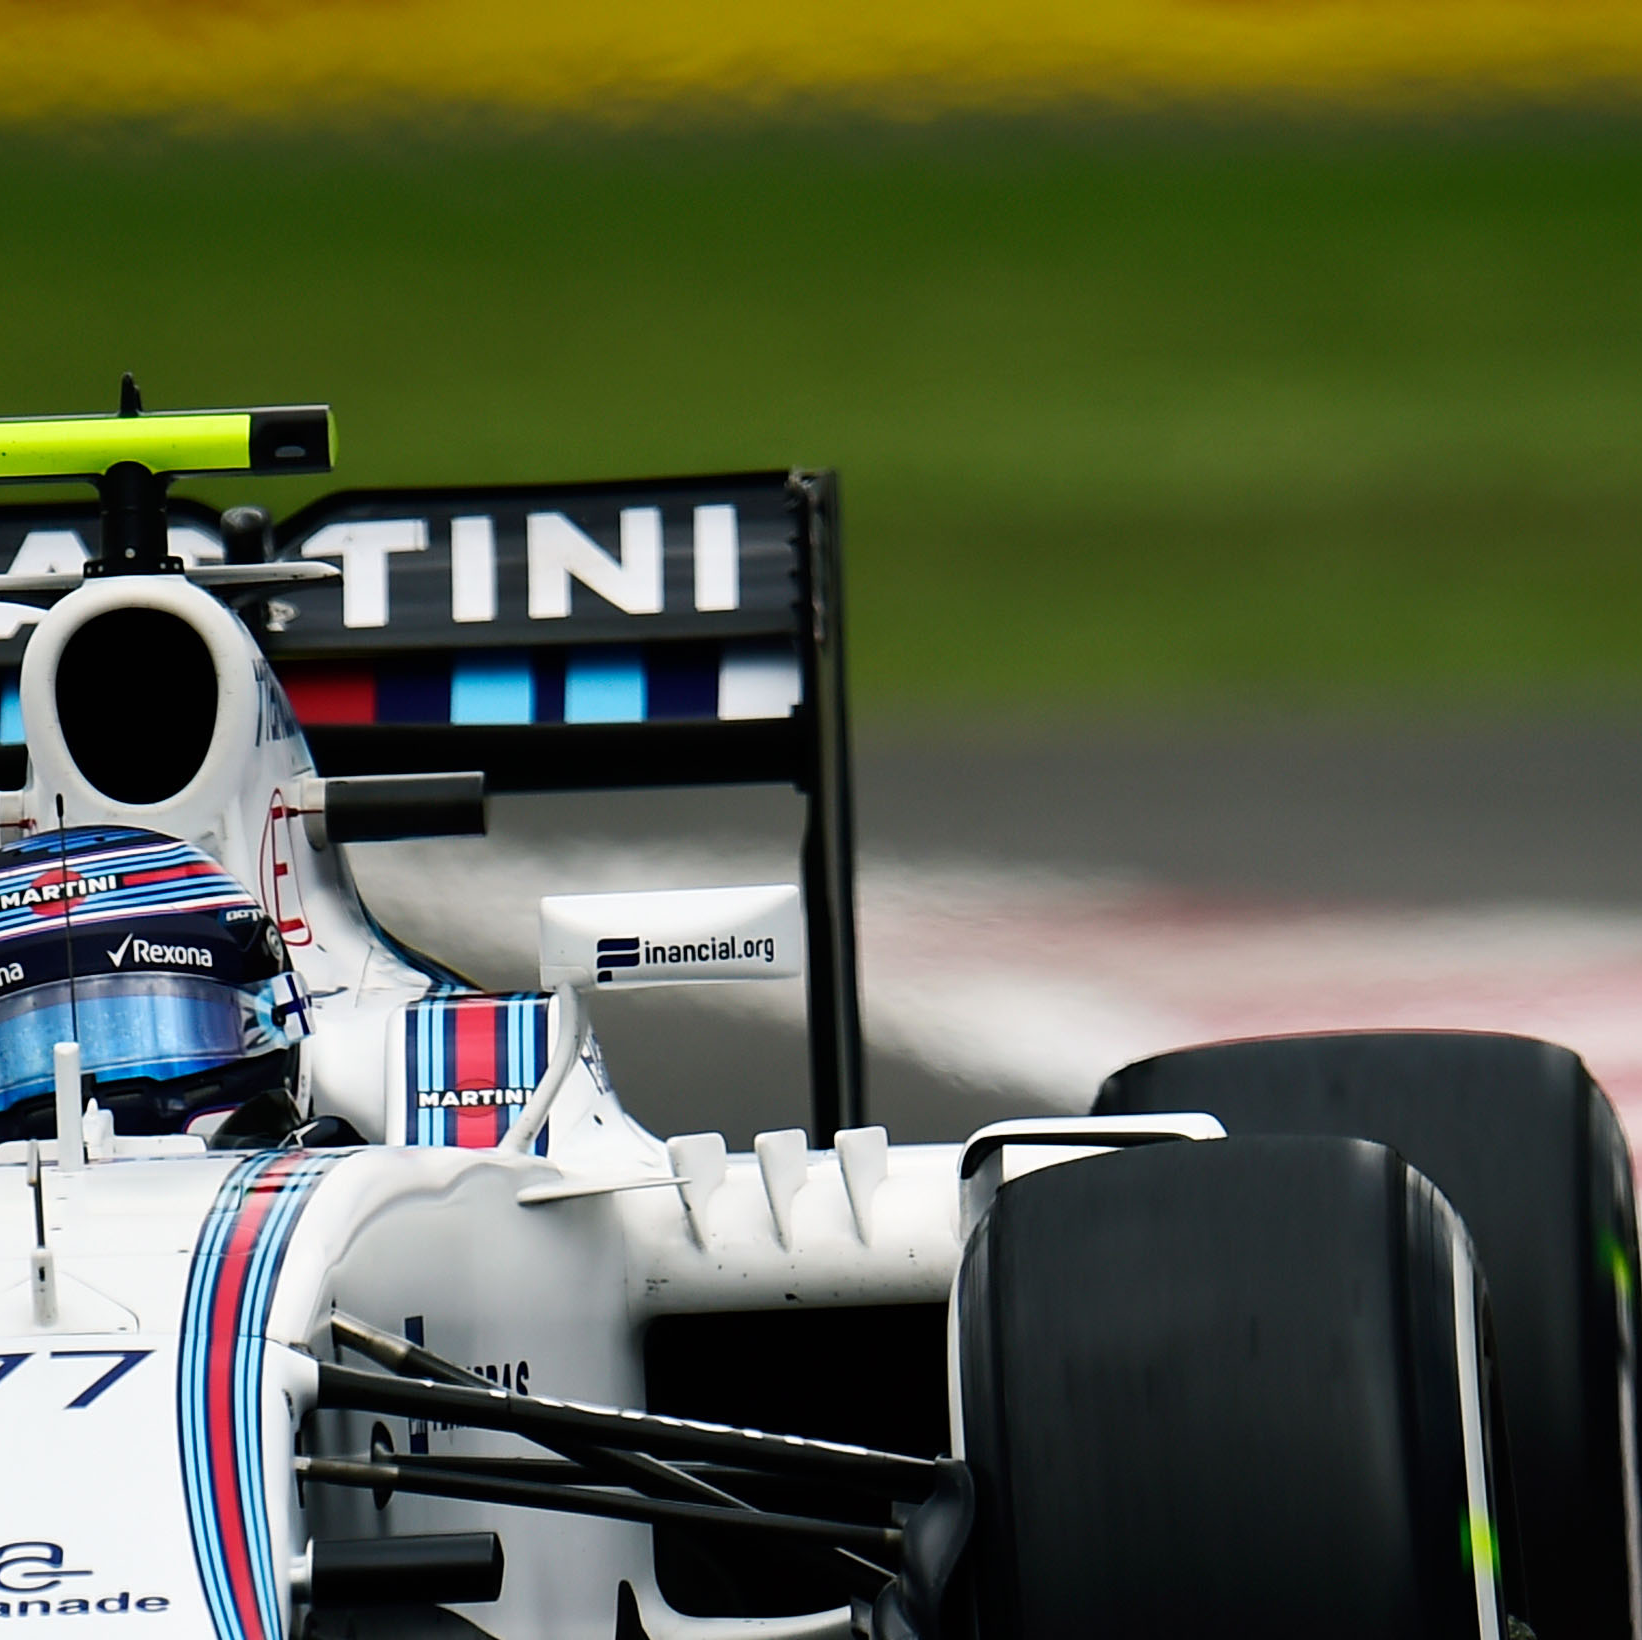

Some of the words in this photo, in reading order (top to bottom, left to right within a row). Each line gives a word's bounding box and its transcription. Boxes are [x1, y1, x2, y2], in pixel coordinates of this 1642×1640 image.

[0, 874, 117, 911] MARTINI
[133, 939, 213, 968] Rexona
[419, 1087, 533, 1107] MARTINI
